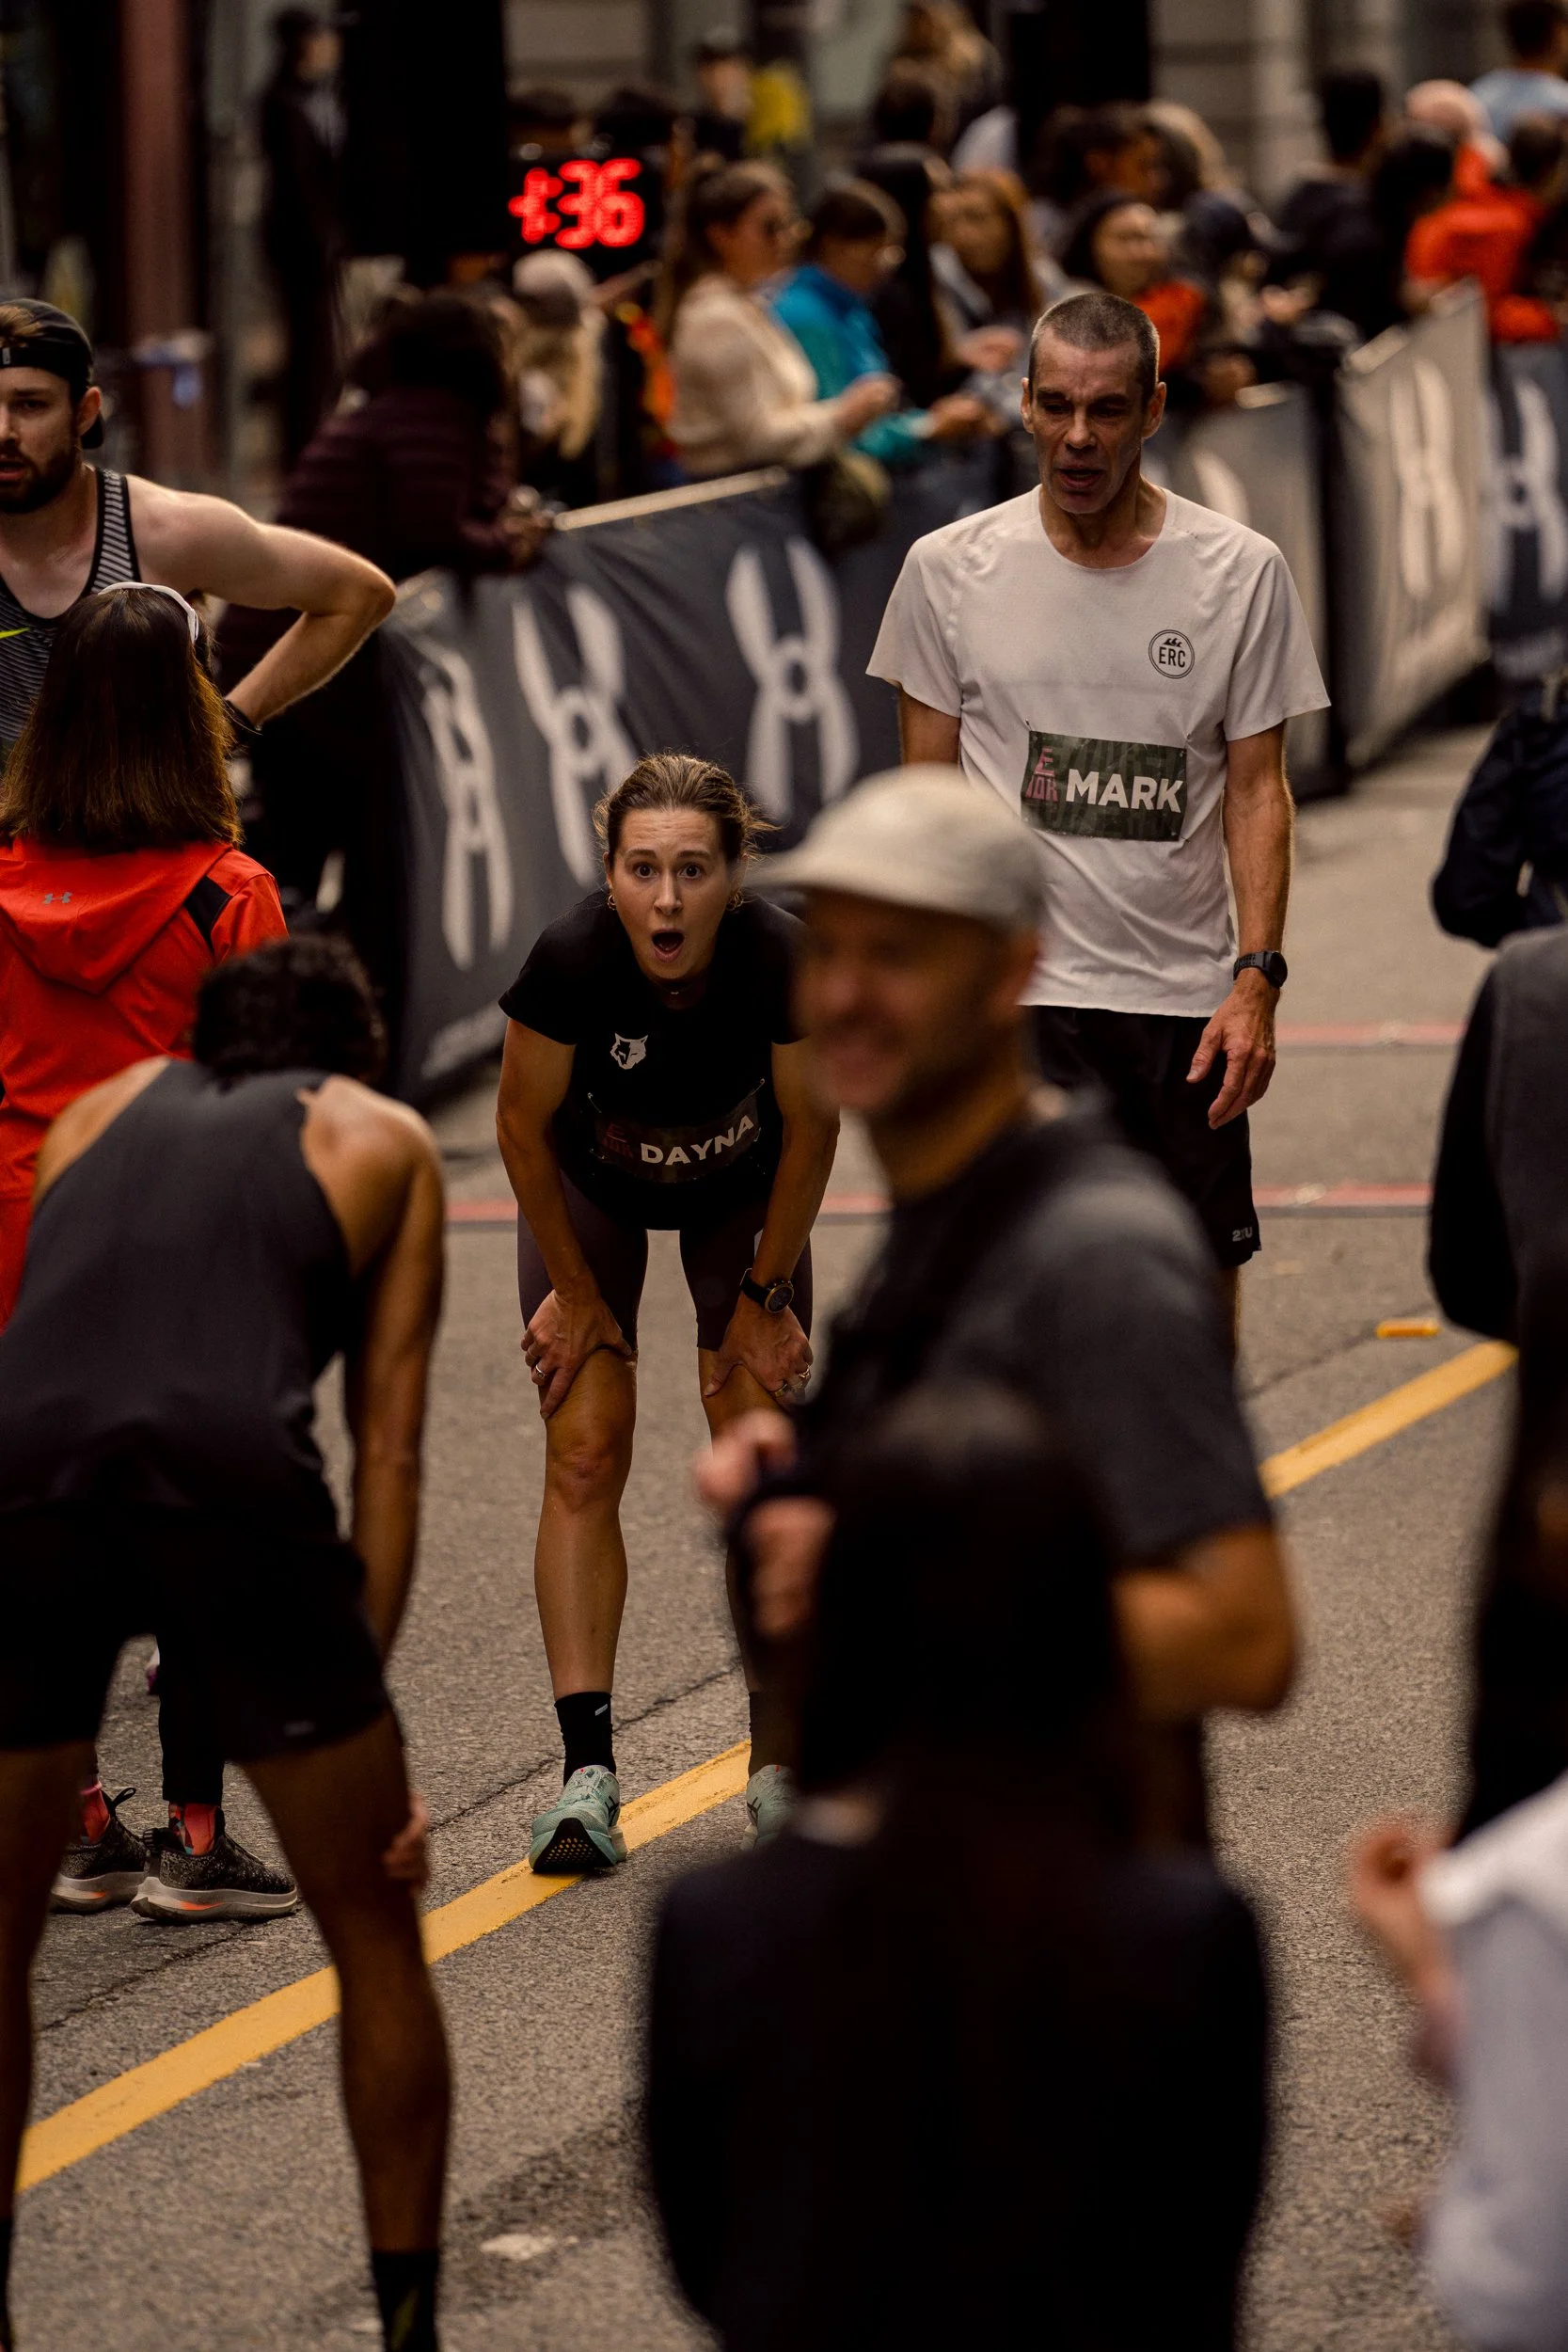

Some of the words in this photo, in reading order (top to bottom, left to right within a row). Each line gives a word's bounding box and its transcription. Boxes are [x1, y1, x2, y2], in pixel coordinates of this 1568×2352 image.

[1158, 646, 1186, 668] ERC
[1066, 769, 1183, 813] MARK
[641, 1115, 754, 1166] DAYNA
